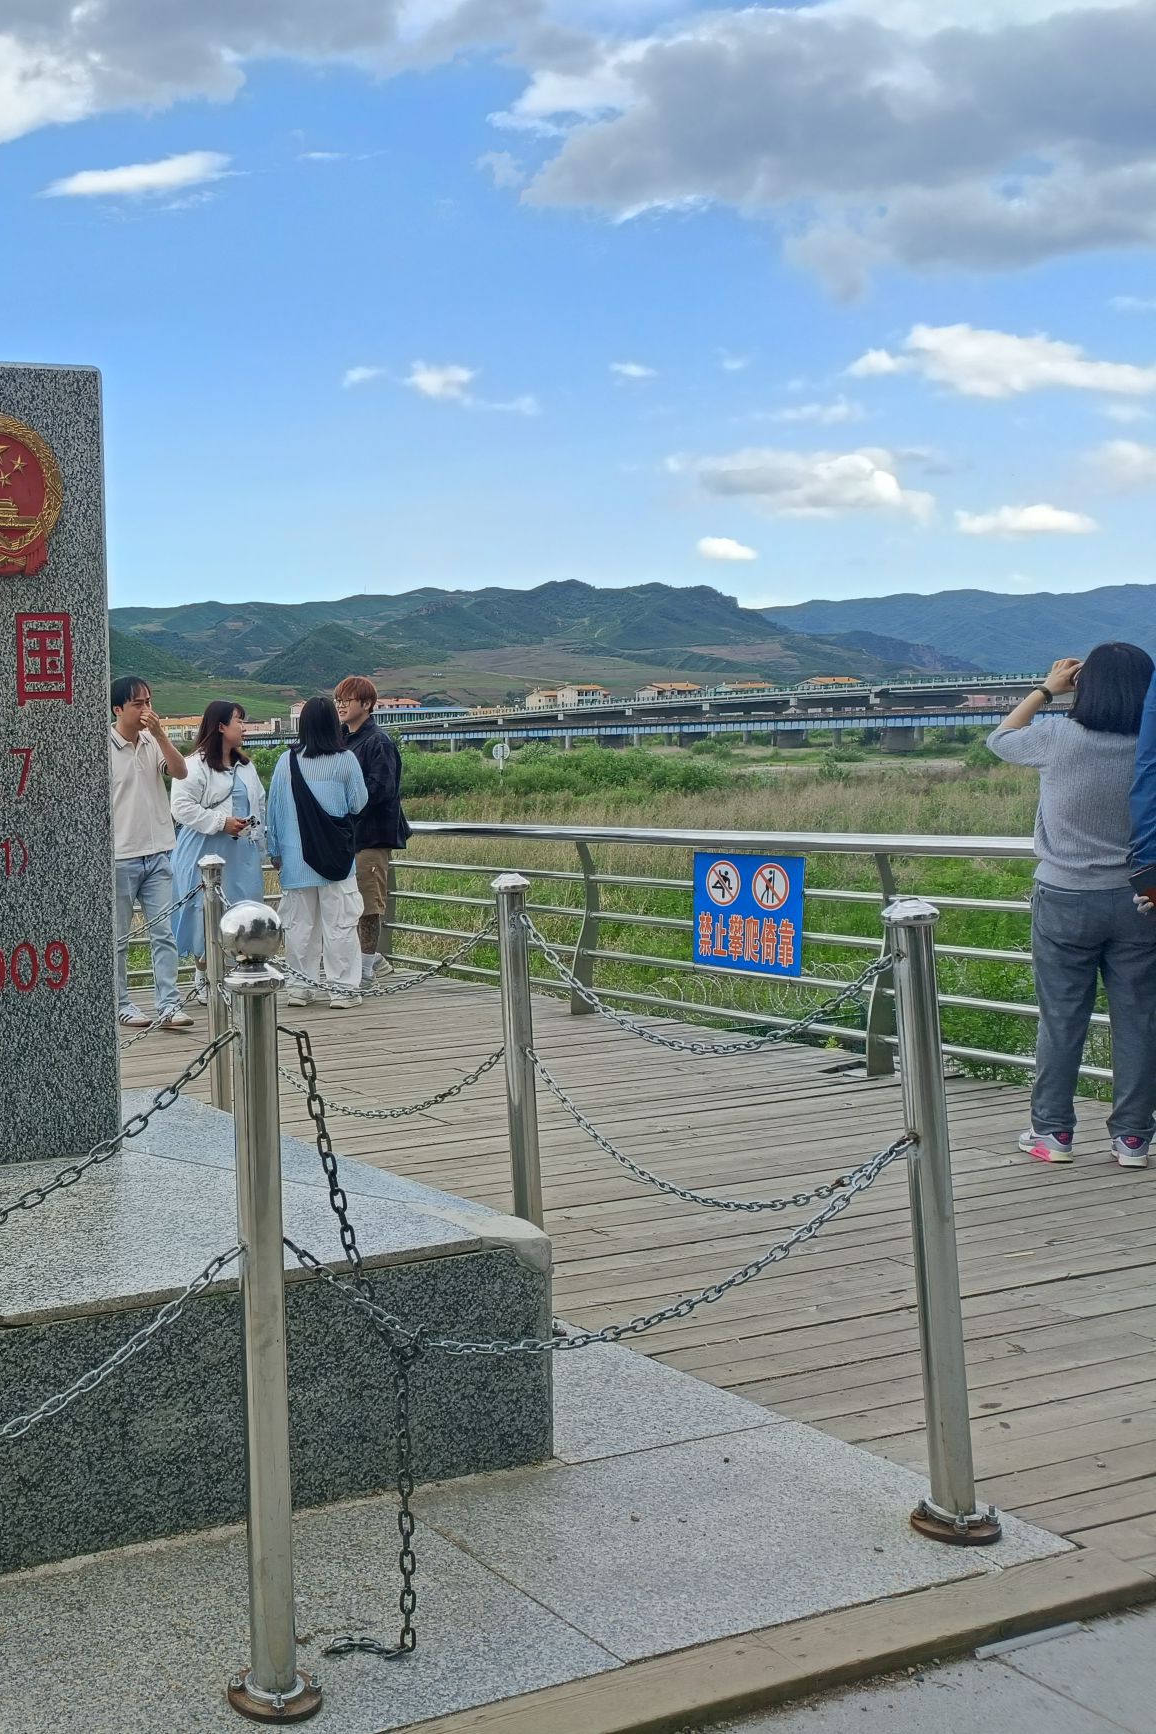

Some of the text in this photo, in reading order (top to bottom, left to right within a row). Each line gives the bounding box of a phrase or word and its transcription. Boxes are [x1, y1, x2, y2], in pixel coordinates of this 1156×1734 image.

[698, 910, 795, 968] 禁止攀爬倚靠
